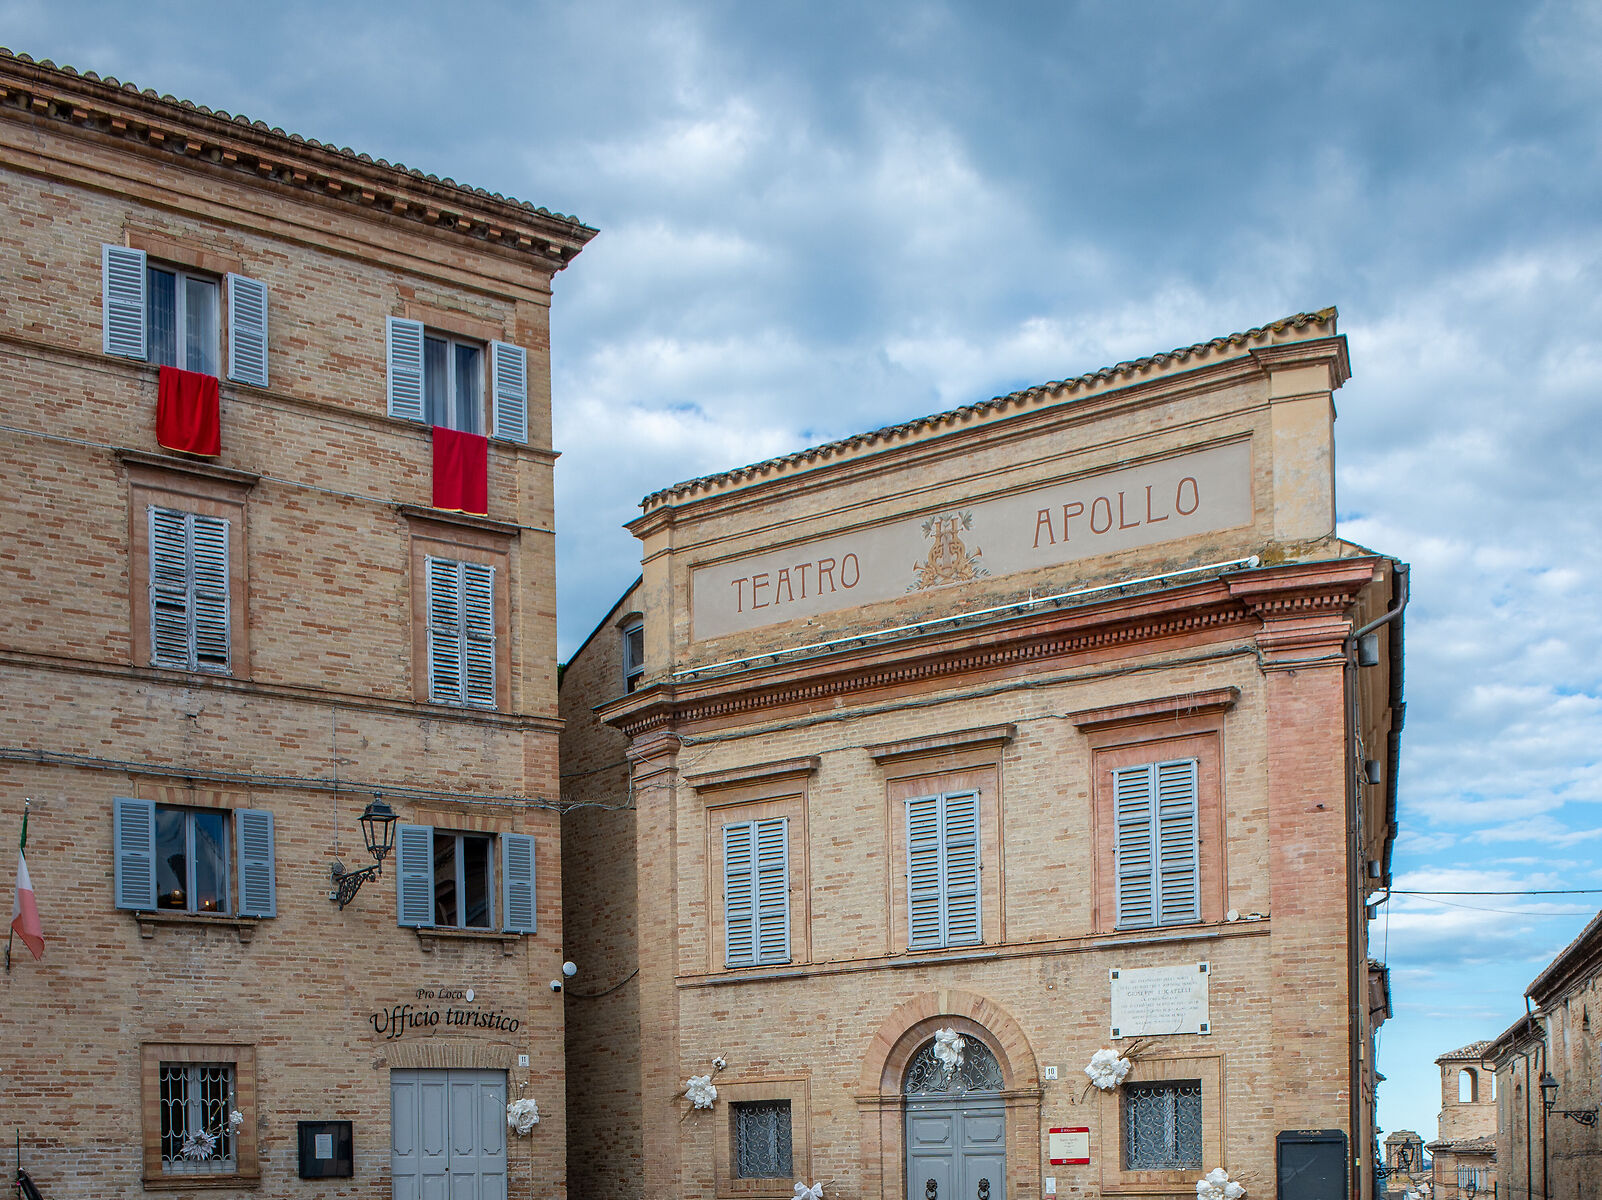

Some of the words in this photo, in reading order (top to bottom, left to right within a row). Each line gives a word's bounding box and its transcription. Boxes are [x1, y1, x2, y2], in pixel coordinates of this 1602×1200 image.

[731, 552, 861, 614] TEATRO
[1033, 476, 1201, 549] APOLLO
[416, 988, 435, 1000] Pro
[438, 988, 463, 1000] Loco
[369, 1004, 440, 1040] Ufficio
[446, 1006, 520, 1033] turistico
[1047, 1067, 1055, 1075] 10
